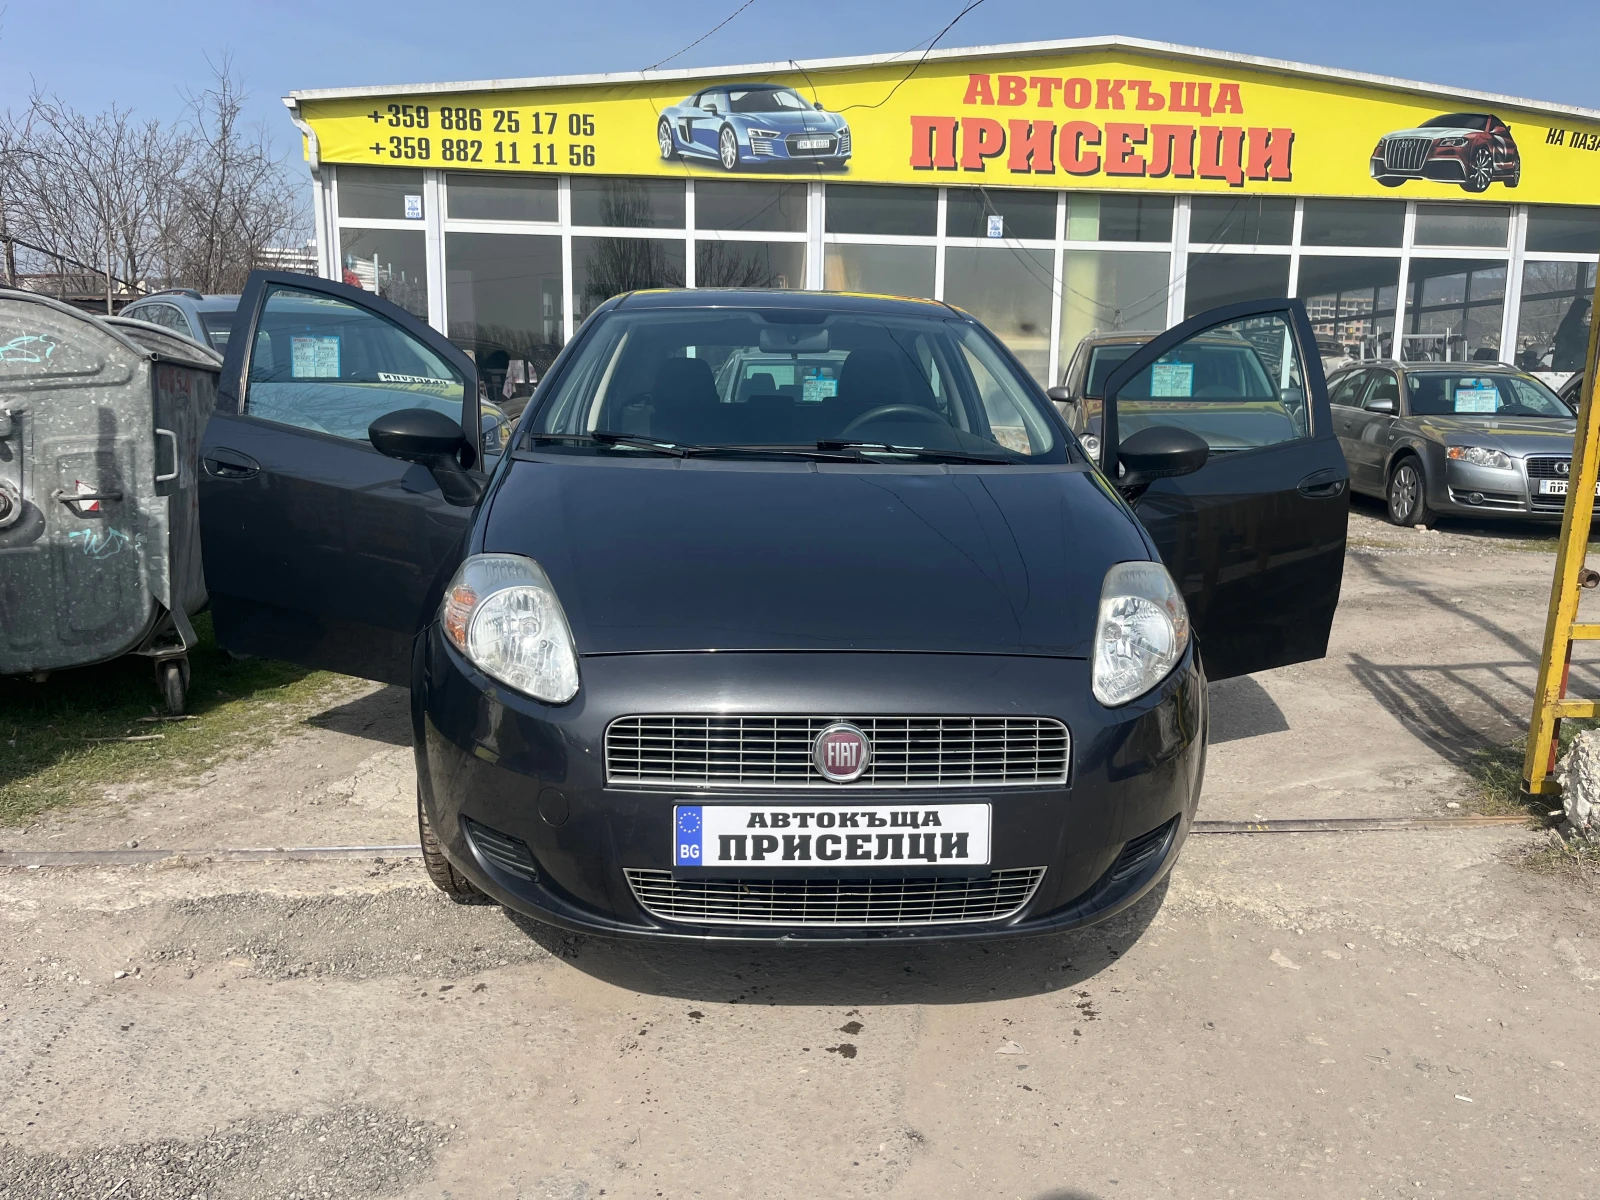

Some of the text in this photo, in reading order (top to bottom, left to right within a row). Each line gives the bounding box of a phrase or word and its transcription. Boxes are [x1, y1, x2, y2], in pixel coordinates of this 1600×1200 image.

[963, 73, 1244, 117] АВТОКЪЩА
[367, 104, 595, 136] +359 886 25 17 05
[369, 136, 595, 167] +359 882 11 11 56
[910, 115, 1295, 186] ПРИСЕЛЦИ
[1545, 128, 1565, 145] НА
[827, 742, 859, 767] FIAT
[746, 811, 942, 829] АВТОКЪЩА
[680, 844, 699, 859] BG
[718, 832, 970, 862] ПРИСЕЛЦИ
